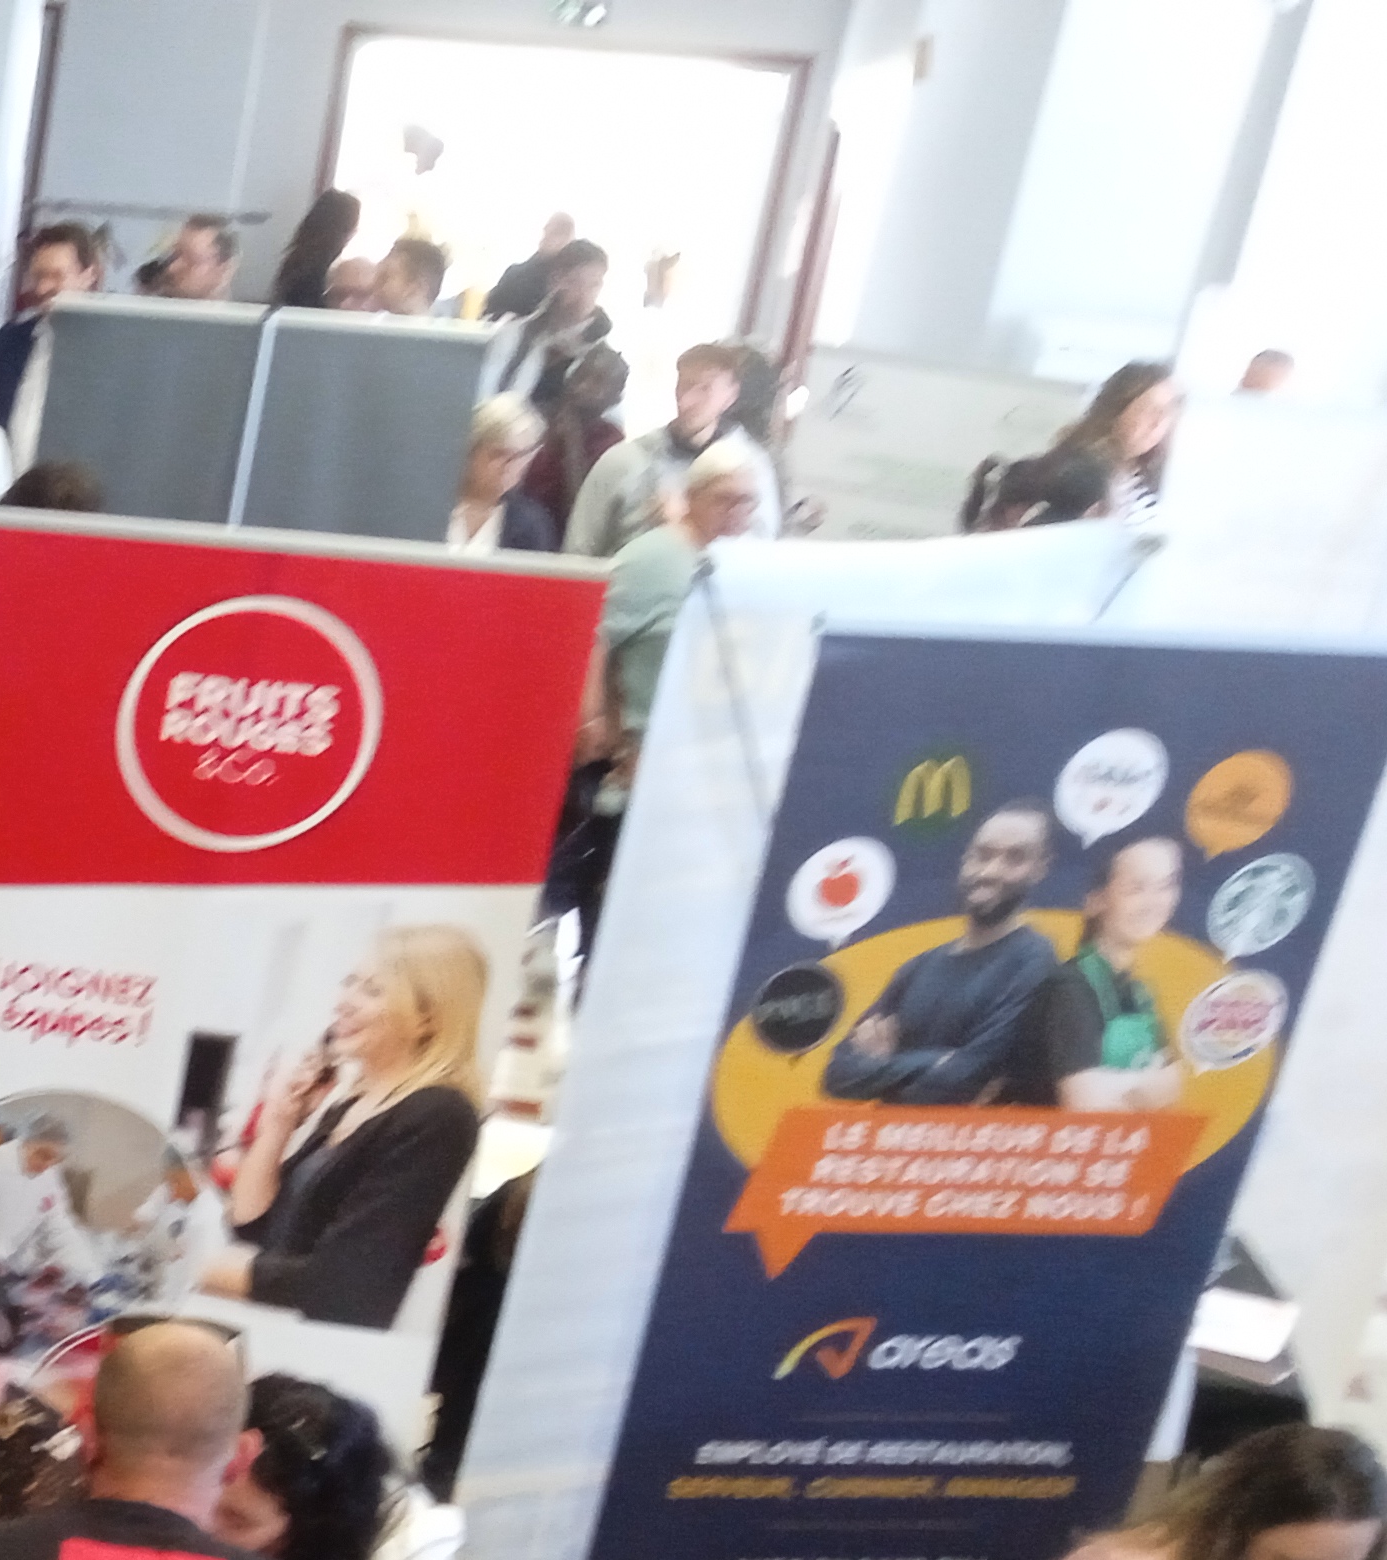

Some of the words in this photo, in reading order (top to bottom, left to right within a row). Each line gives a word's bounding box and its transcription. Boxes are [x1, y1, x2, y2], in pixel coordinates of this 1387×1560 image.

[165, 671, 342, 721] FRUITS
[159, 707, 334, 757] ROUGES
[822, 1121, 871, 1151] LE
[874, 1121, 1049, 1153] MEILLEUR
[1050, 1125, 1101, 1155] DE
[1102, 1126, 1150, 1155] LA
[810, 1153, 1080, 1185] RESTAURATION
[1084, 1157, 1134, 1187] SE
[779, 1186, 923, 1217] TROUVE
[924, 1189, 1022, 1220] CHEZ
[1023, 1191, 1126, 1221] NOUS
[867, 1333, 1022, 1371] areas
[693, 1436, 827, 1466] EMPLOYÉ
[824, 1438, 869, 1466] DE
